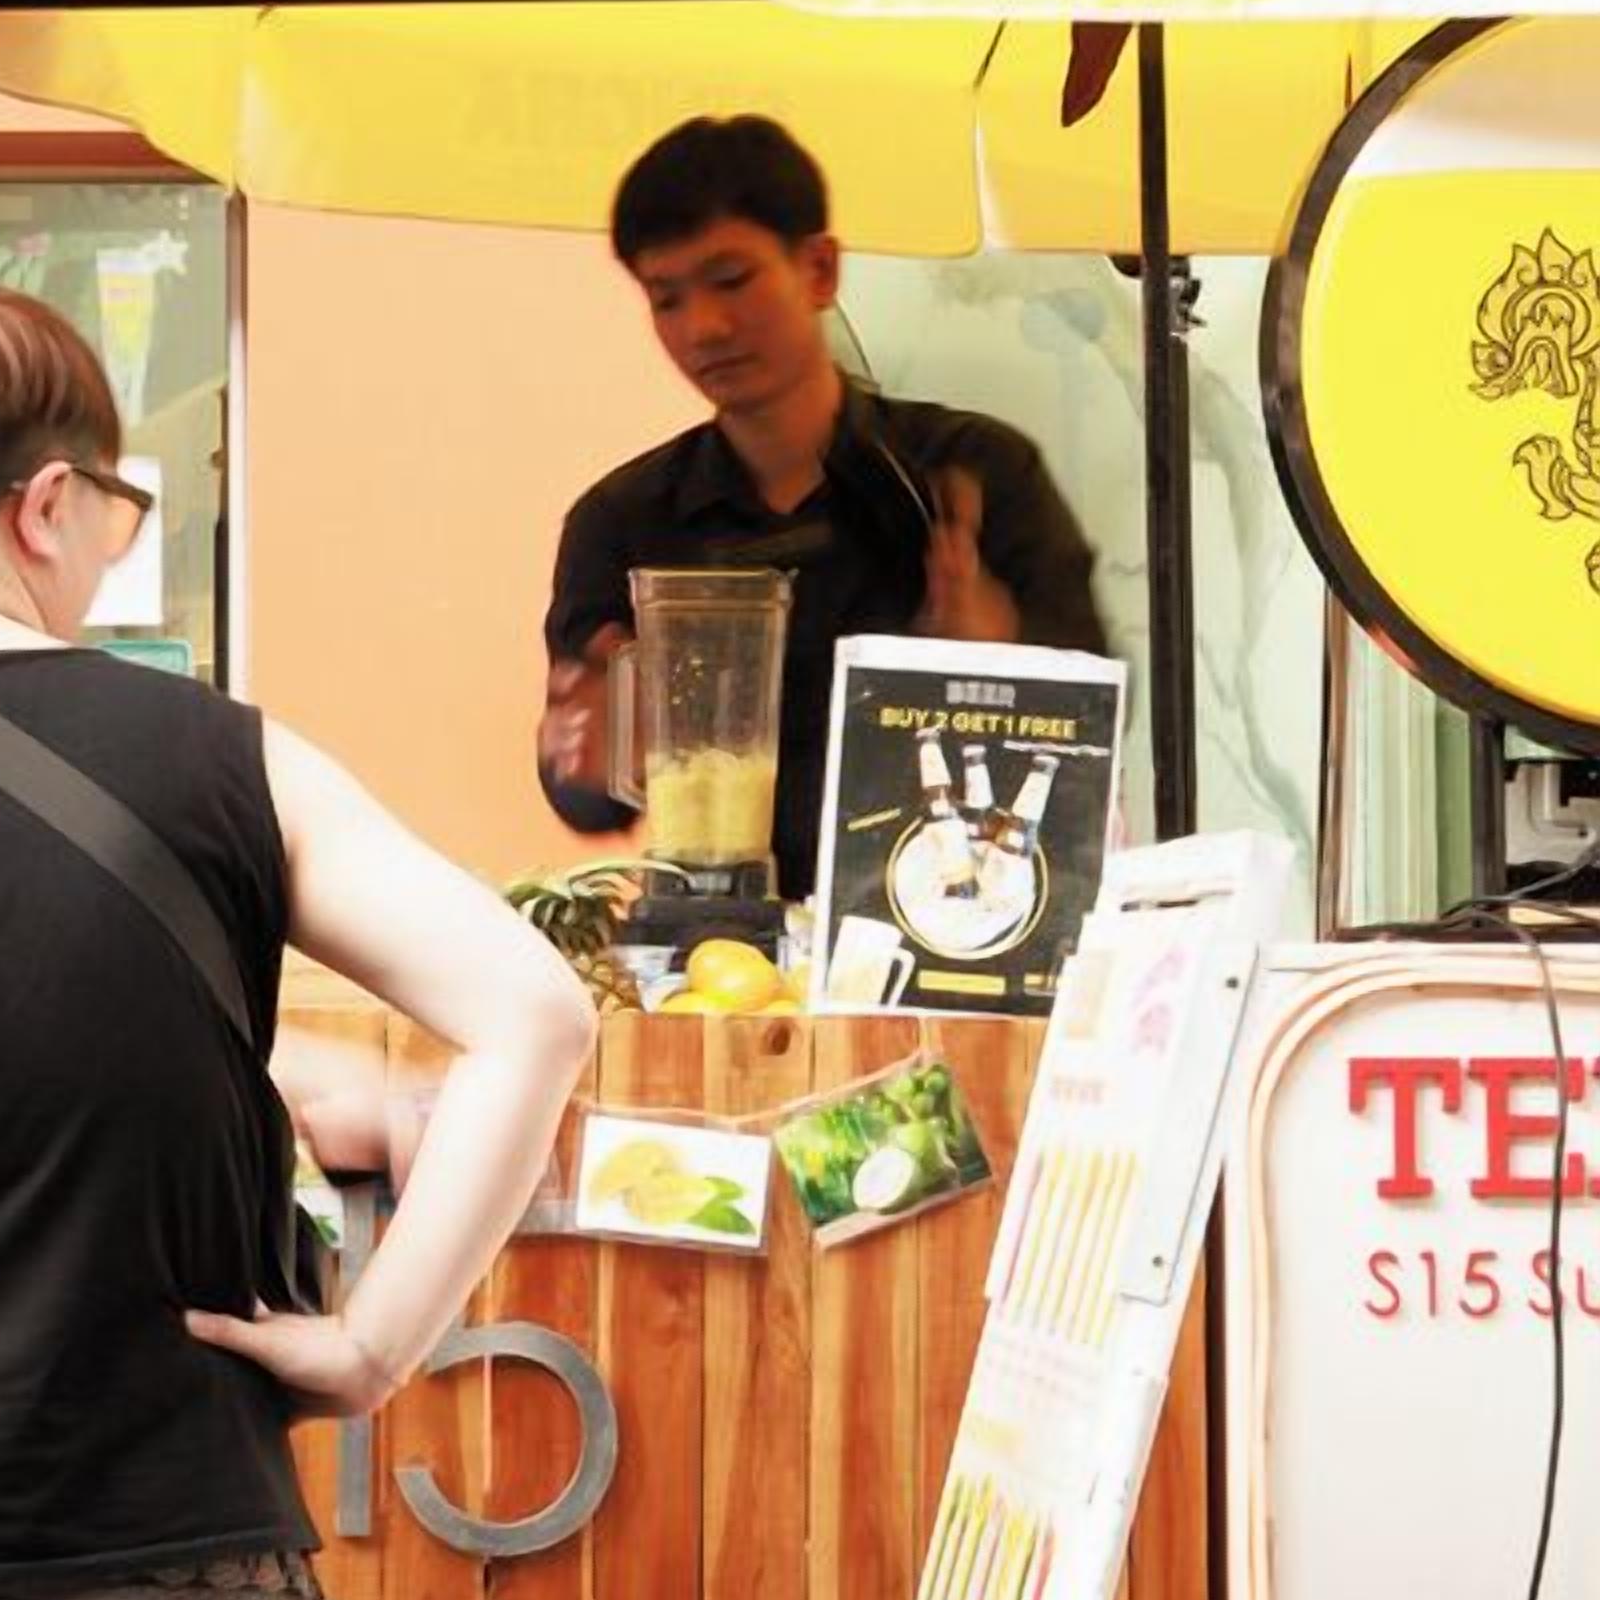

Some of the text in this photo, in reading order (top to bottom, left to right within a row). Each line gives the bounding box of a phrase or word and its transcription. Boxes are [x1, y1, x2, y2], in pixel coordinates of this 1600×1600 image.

[879, 705, 928, 729] BUY
[951, 710, 1001, 734] GET
[1005, 713, 1014, 735] 1
[1018, 715, 1078, 741] FREE
[1348, 1056, 1600, 1199] TE
[1365, 1251, 1501, 1317] S15
